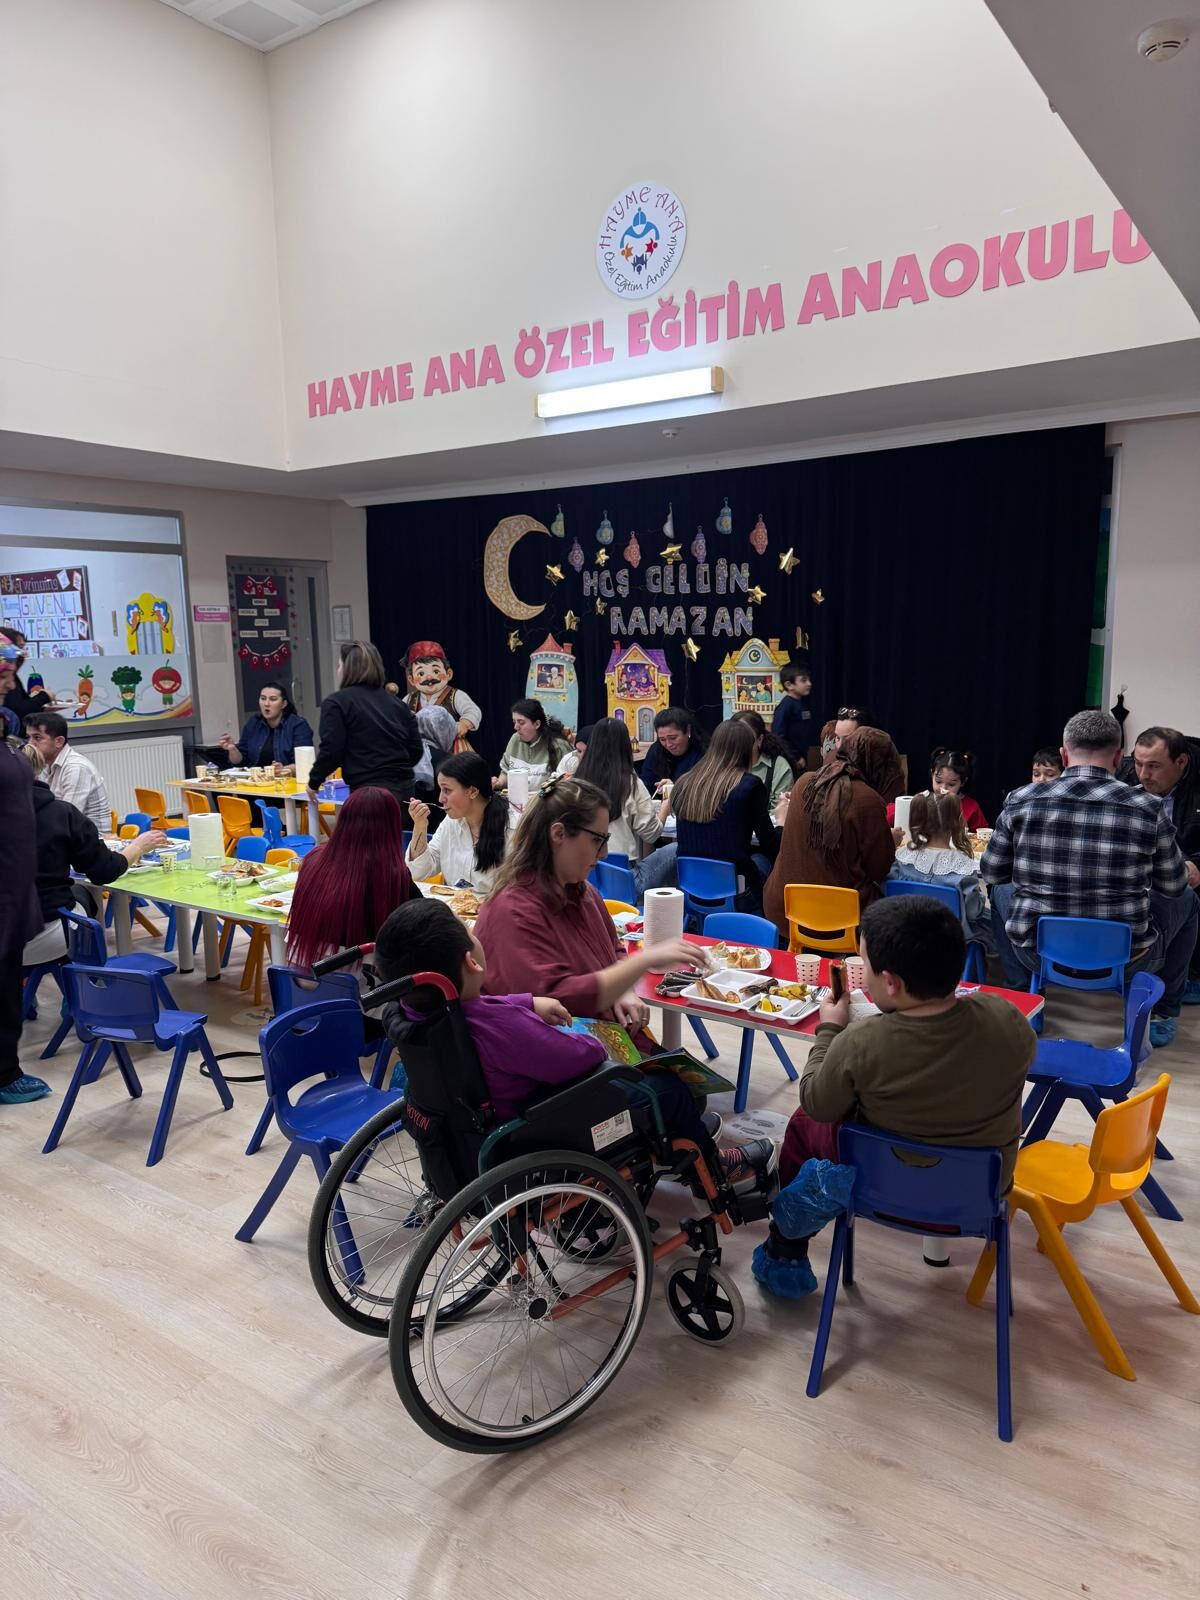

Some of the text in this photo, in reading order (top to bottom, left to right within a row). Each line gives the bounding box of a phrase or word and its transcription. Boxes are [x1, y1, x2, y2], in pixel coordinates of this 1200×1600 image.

[599, 186, 685, 249] HAYME ANA
[646, 235, 677, 290] Anaokulu
[307, 207, 1152, 418] HAYME ANA ÖZEL EĞİTİM ANAOKULU
[582, 557, 750, 598] HOŞ GELDİN
[610, 606, 753, 637] RAMAZAN
